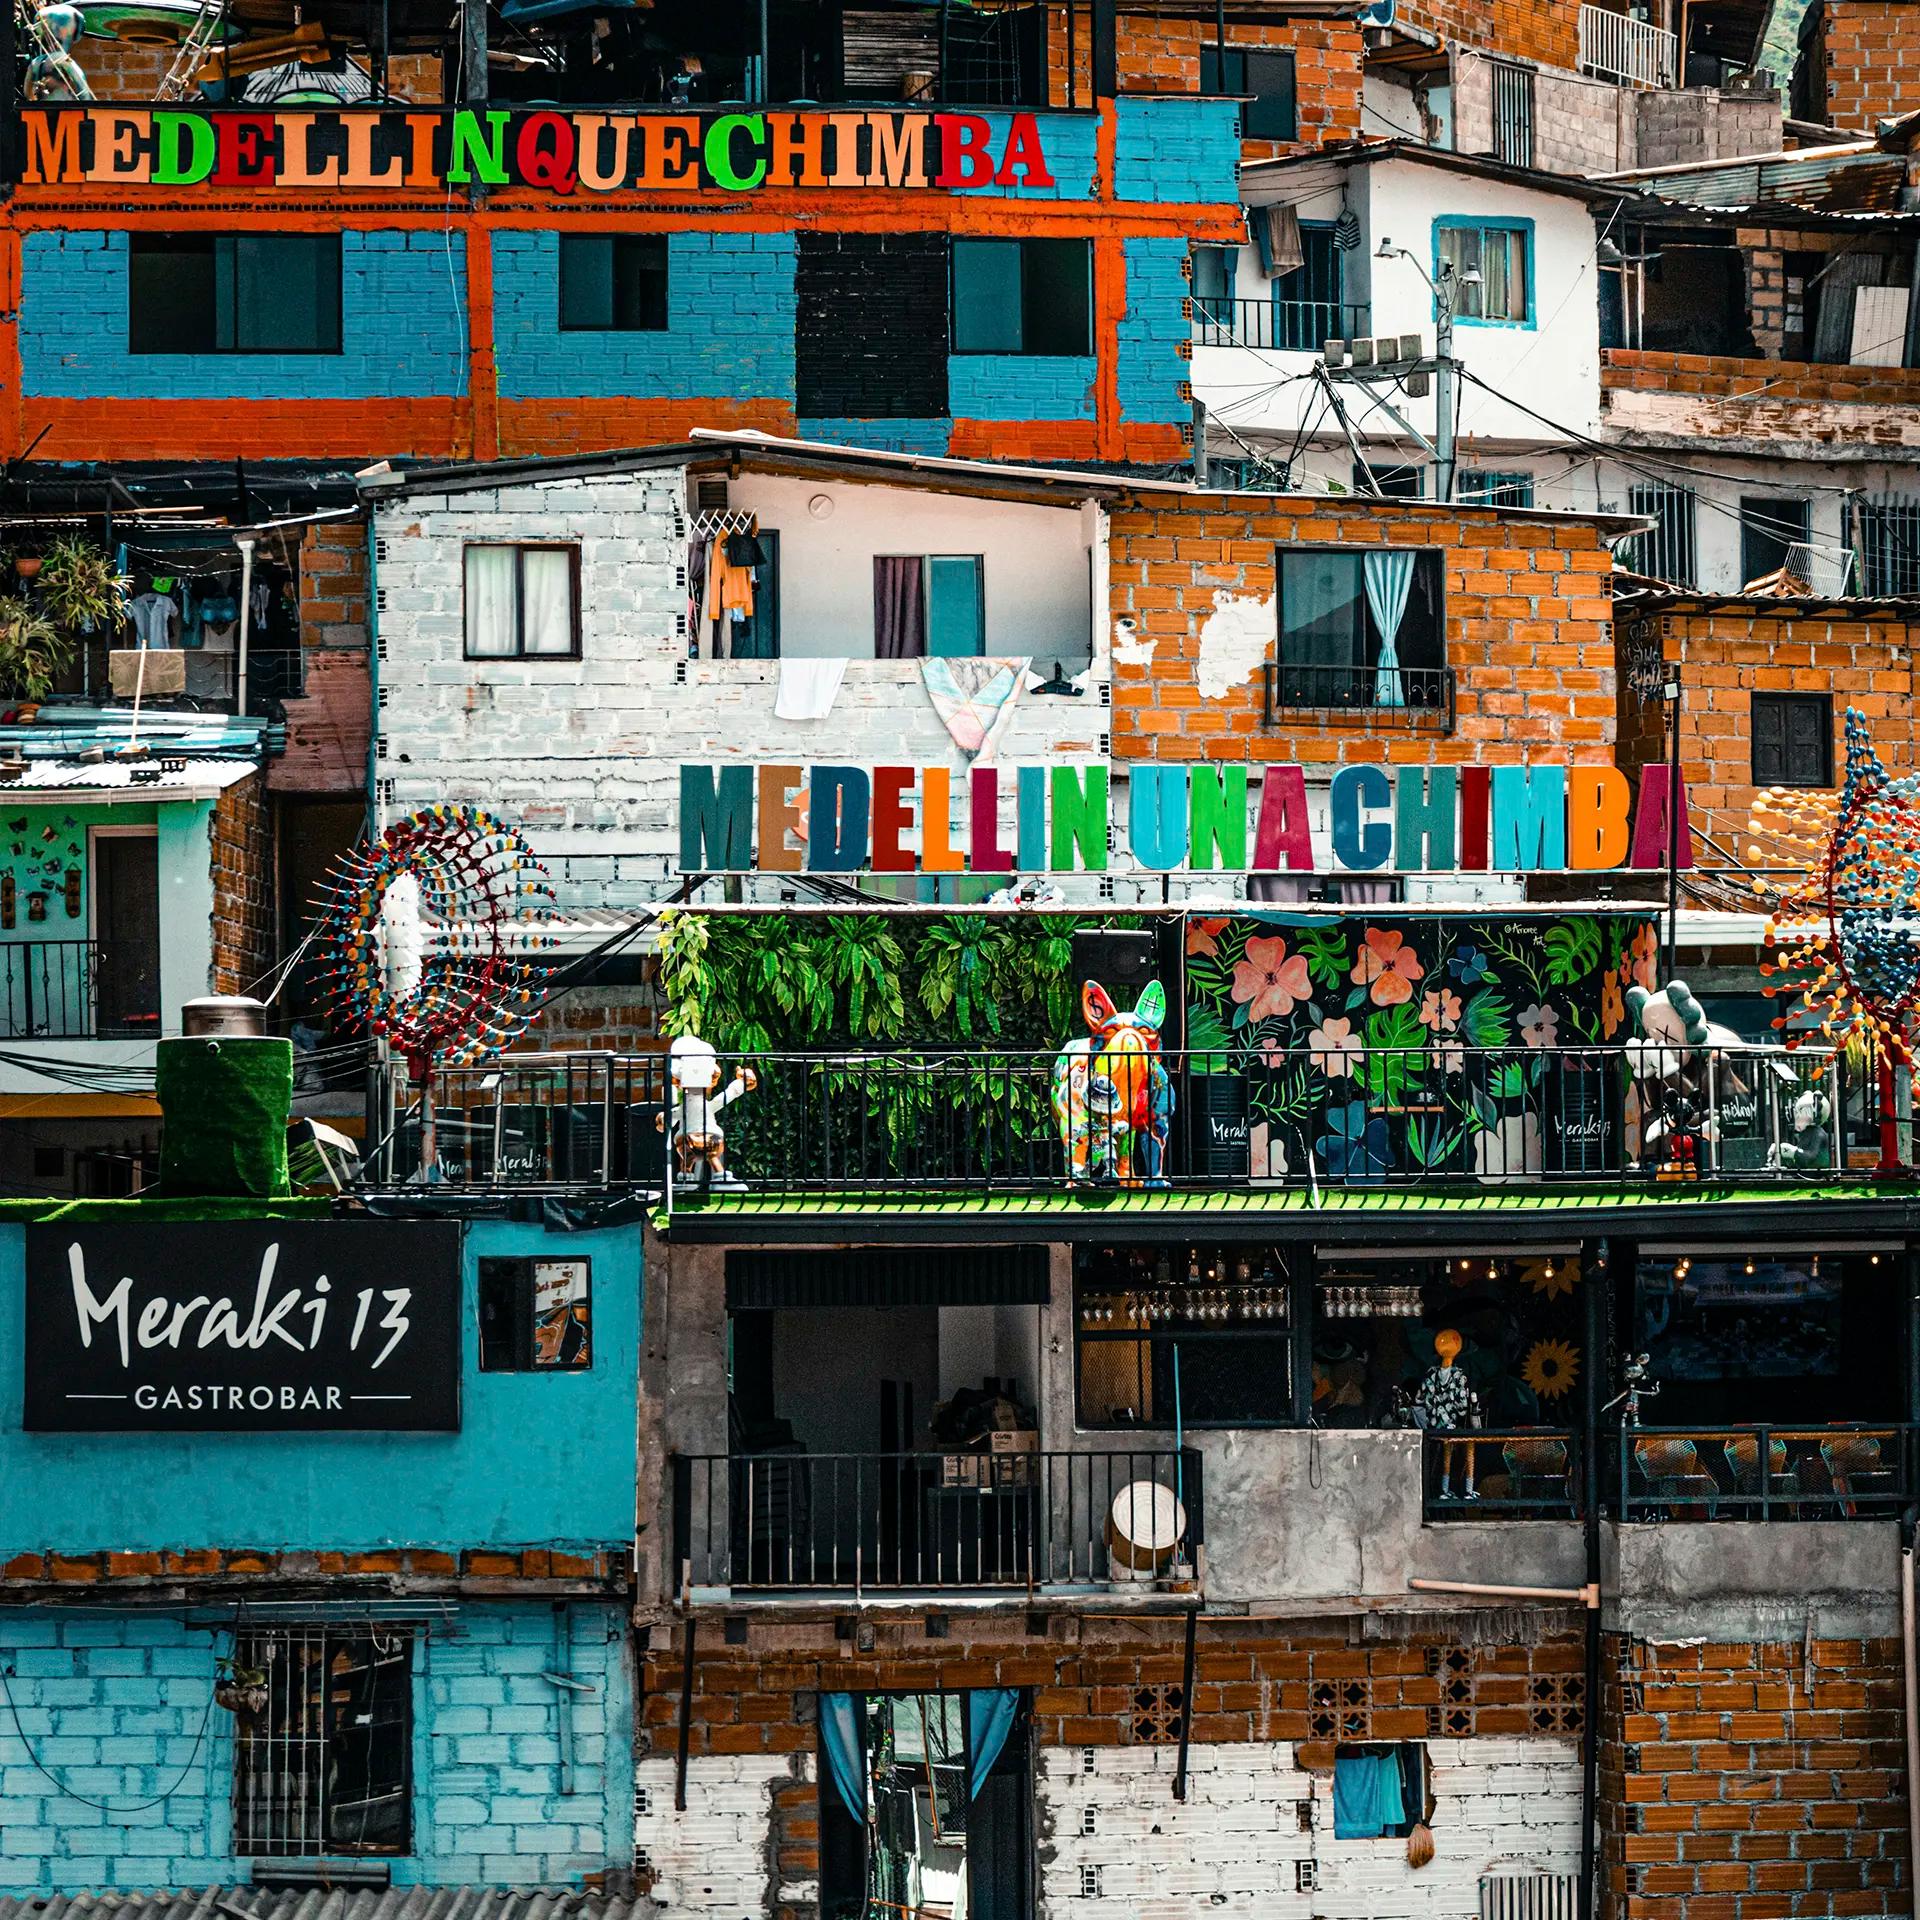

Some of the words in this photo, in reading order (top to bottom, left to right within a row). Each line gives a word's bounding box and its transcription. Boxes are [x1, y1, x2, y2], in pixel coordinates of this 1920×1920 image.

[67, 1242, 332, 1368] Meraki
[349, 1286, 411, 1370] 13
[134, 1384, 343, 1410] GASTROBAR
